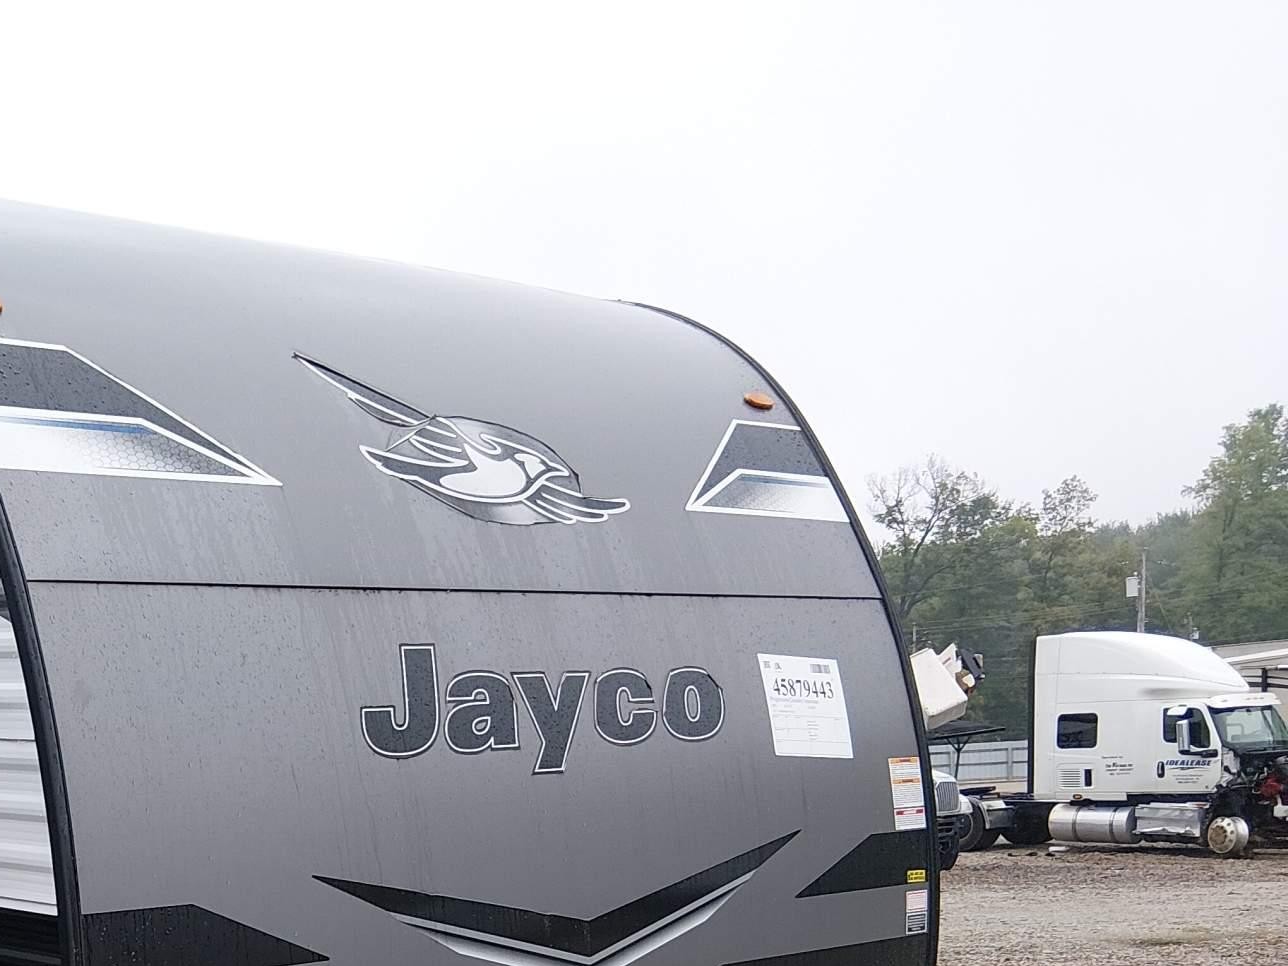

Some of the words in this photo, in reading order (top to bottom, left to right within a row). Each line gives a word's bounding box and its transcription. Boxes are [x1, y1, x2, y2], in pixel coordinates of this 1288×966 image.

[773, 678, 834, 699] 45879443
[360, 643, 725, 775] Jayco
[1165, 759, 1212, 767] IDEALEASE
